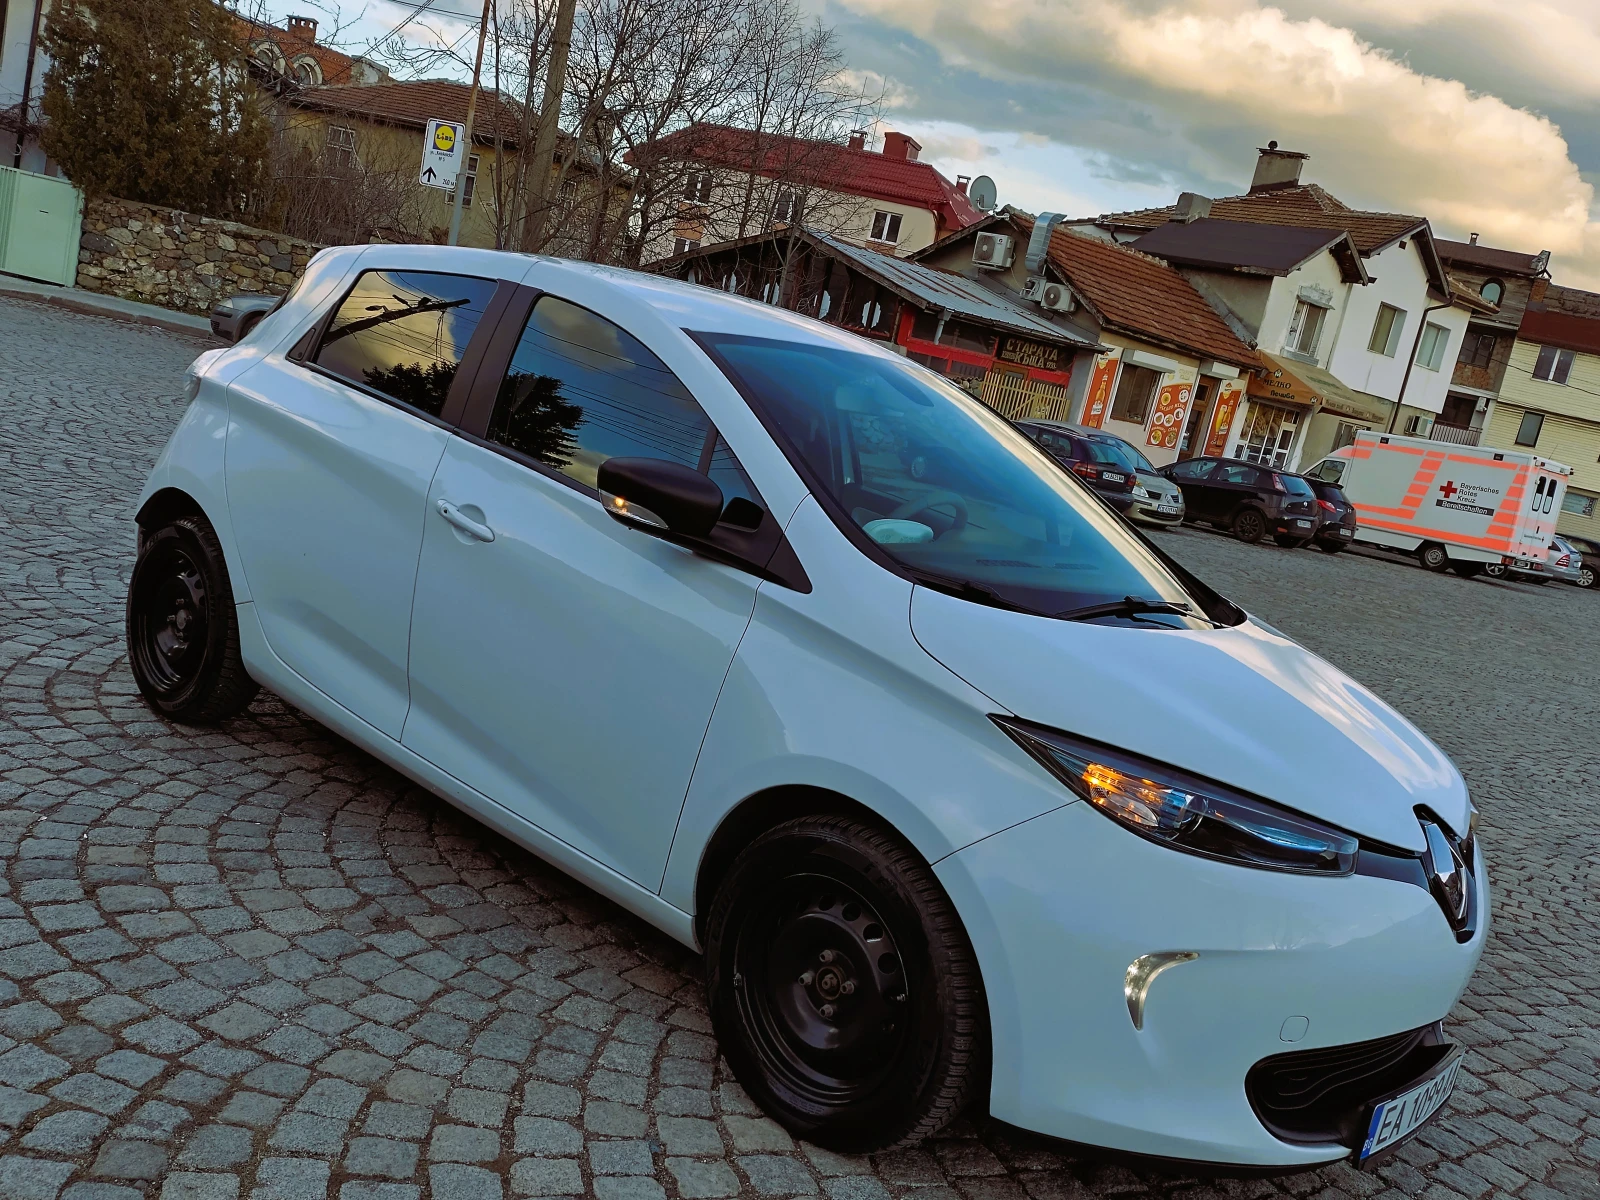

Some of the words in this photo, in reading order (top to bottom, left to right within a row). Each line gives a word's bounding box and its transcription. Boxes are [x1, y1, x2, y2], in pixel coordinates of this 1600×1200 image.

[1006, 338, 1059, 361] СТАРАТА
[1458, 489, 1478, 497] Rotes
[1460, 482, 1499, 494] Bayerisches
[1457, 495, 1476, 503] Kreuz
[1441, 500, 1487, 515] Bereitschaften
[1376, 1100, 1406, 1146] EA
[1407, 1074, 1446, 1128] 1099
